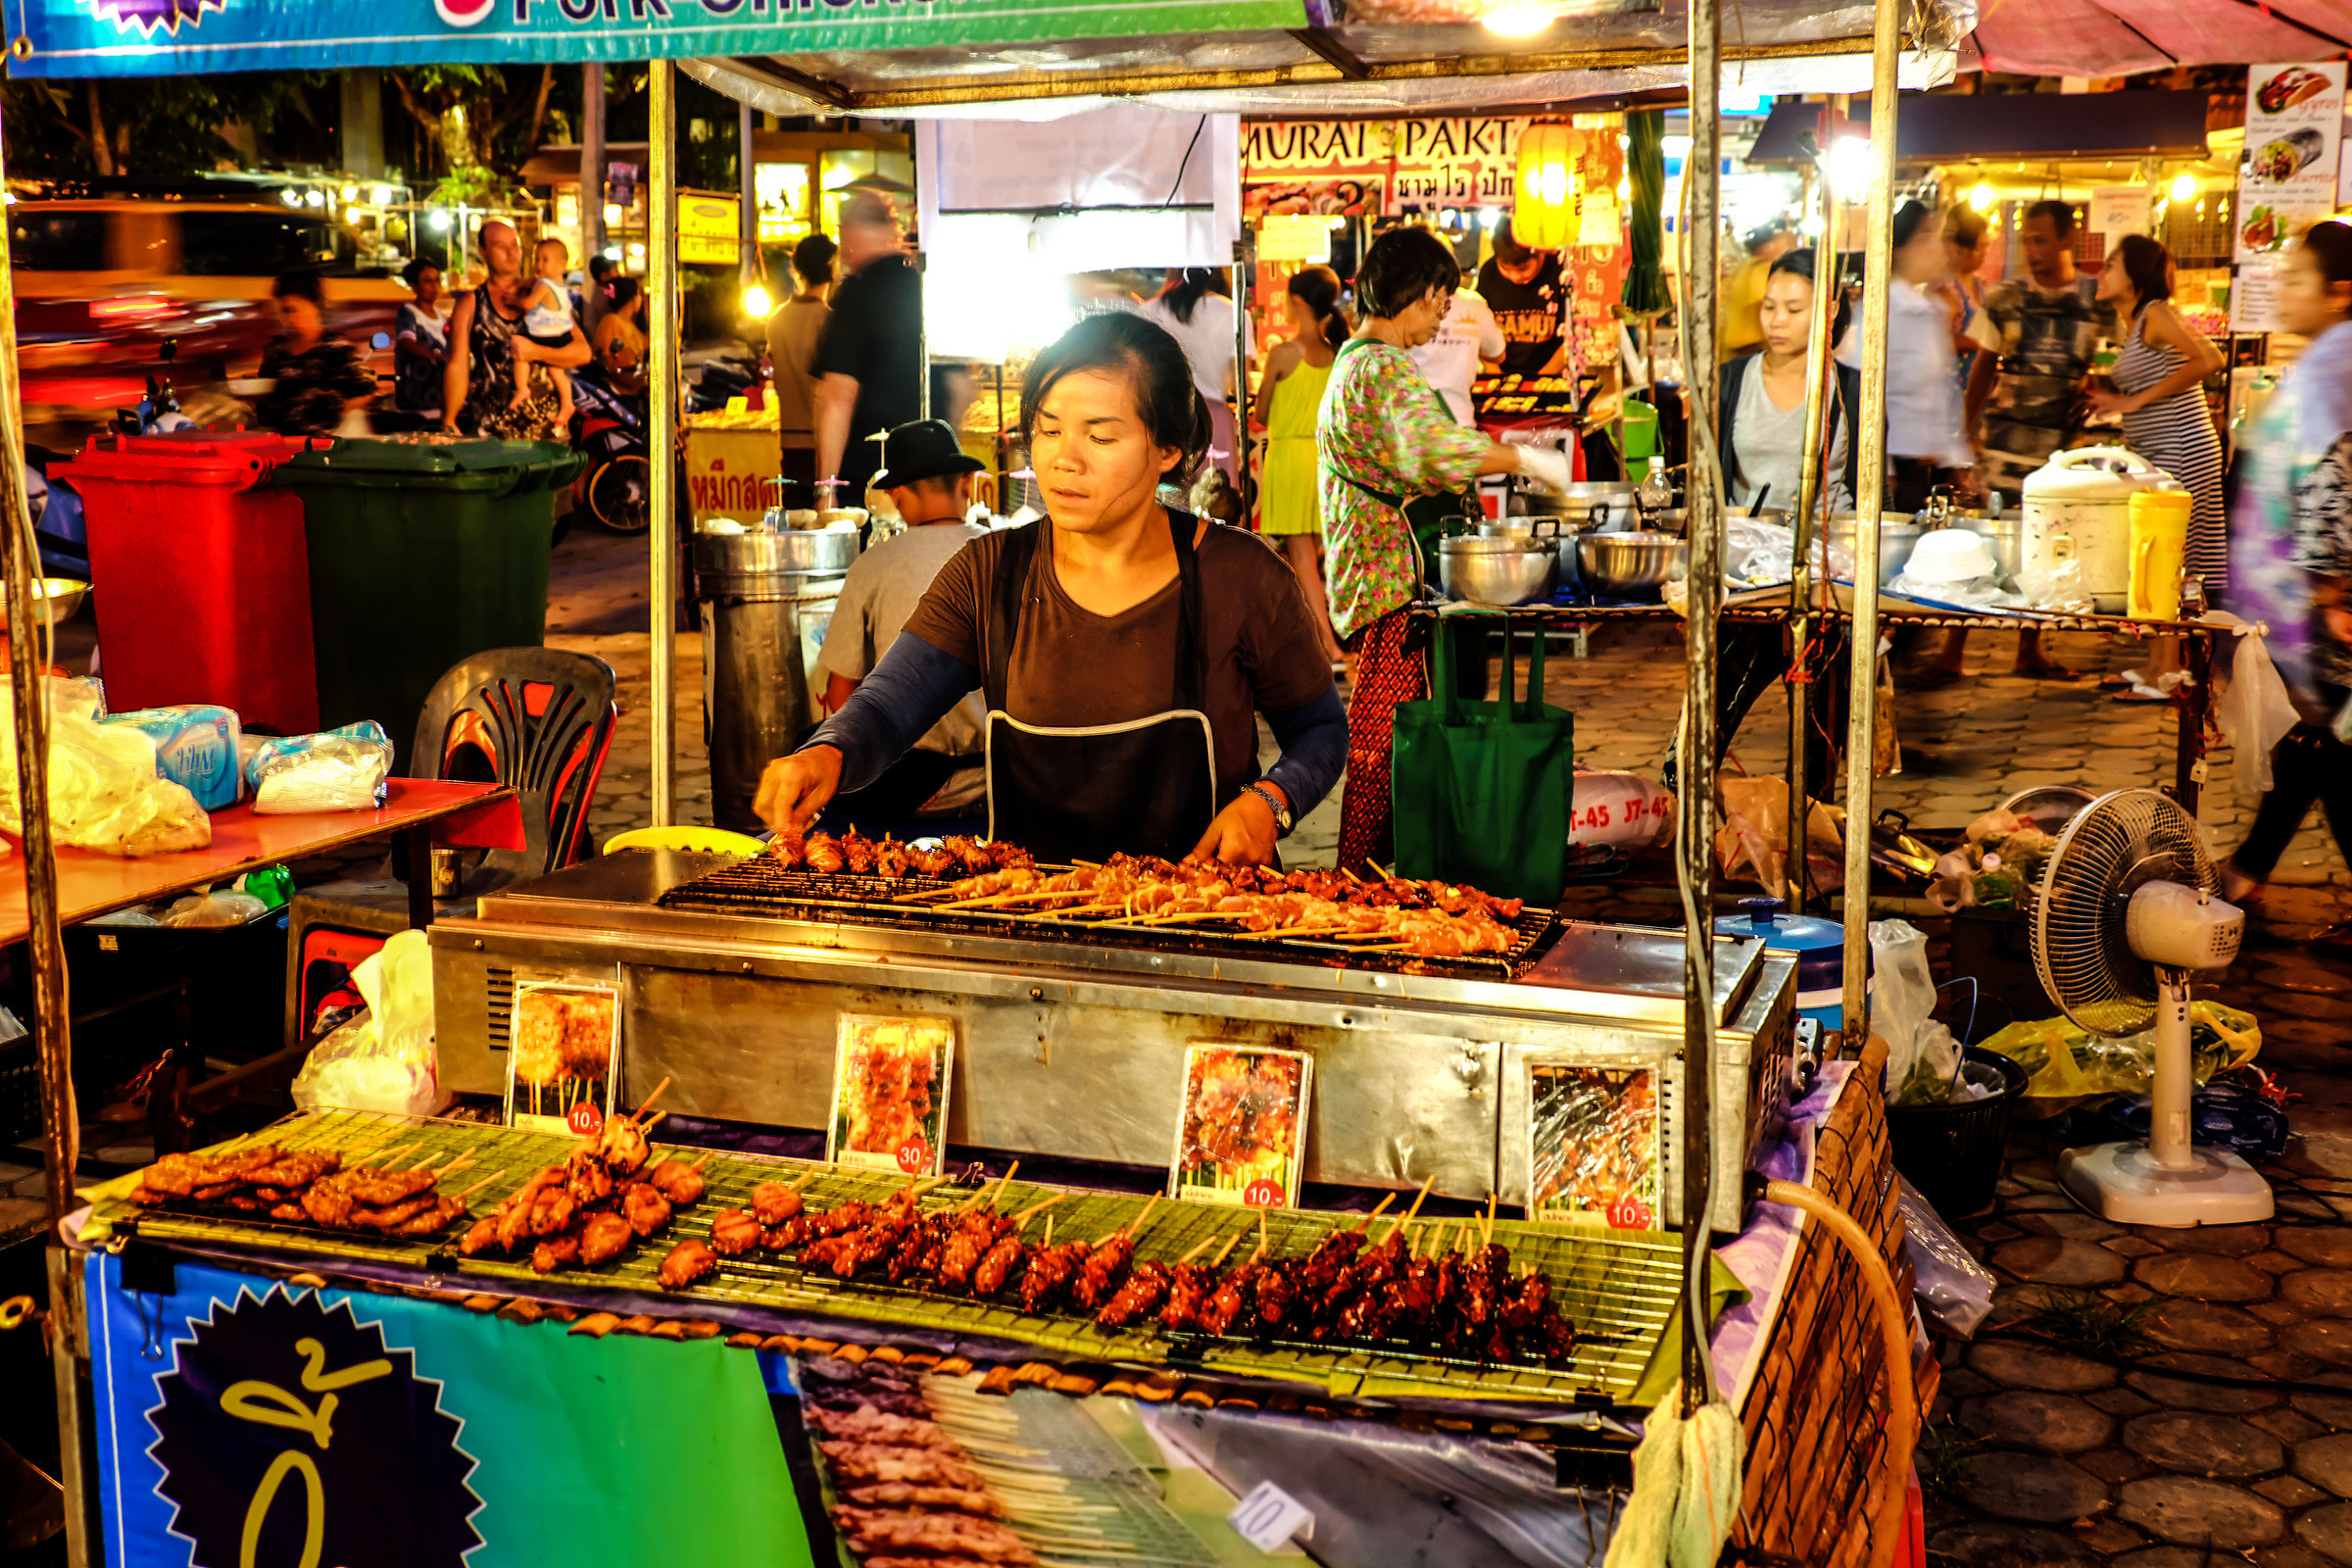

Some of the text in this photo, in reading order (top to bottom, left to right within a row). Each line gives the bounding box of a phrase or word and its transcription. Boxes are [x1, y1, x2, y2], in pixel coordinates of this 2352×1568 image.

[1404, 118, 1531, 158] PAKT
[1624, 796, 1669, 823] JT-45
[900, 1146, 932, 1165] 30-
